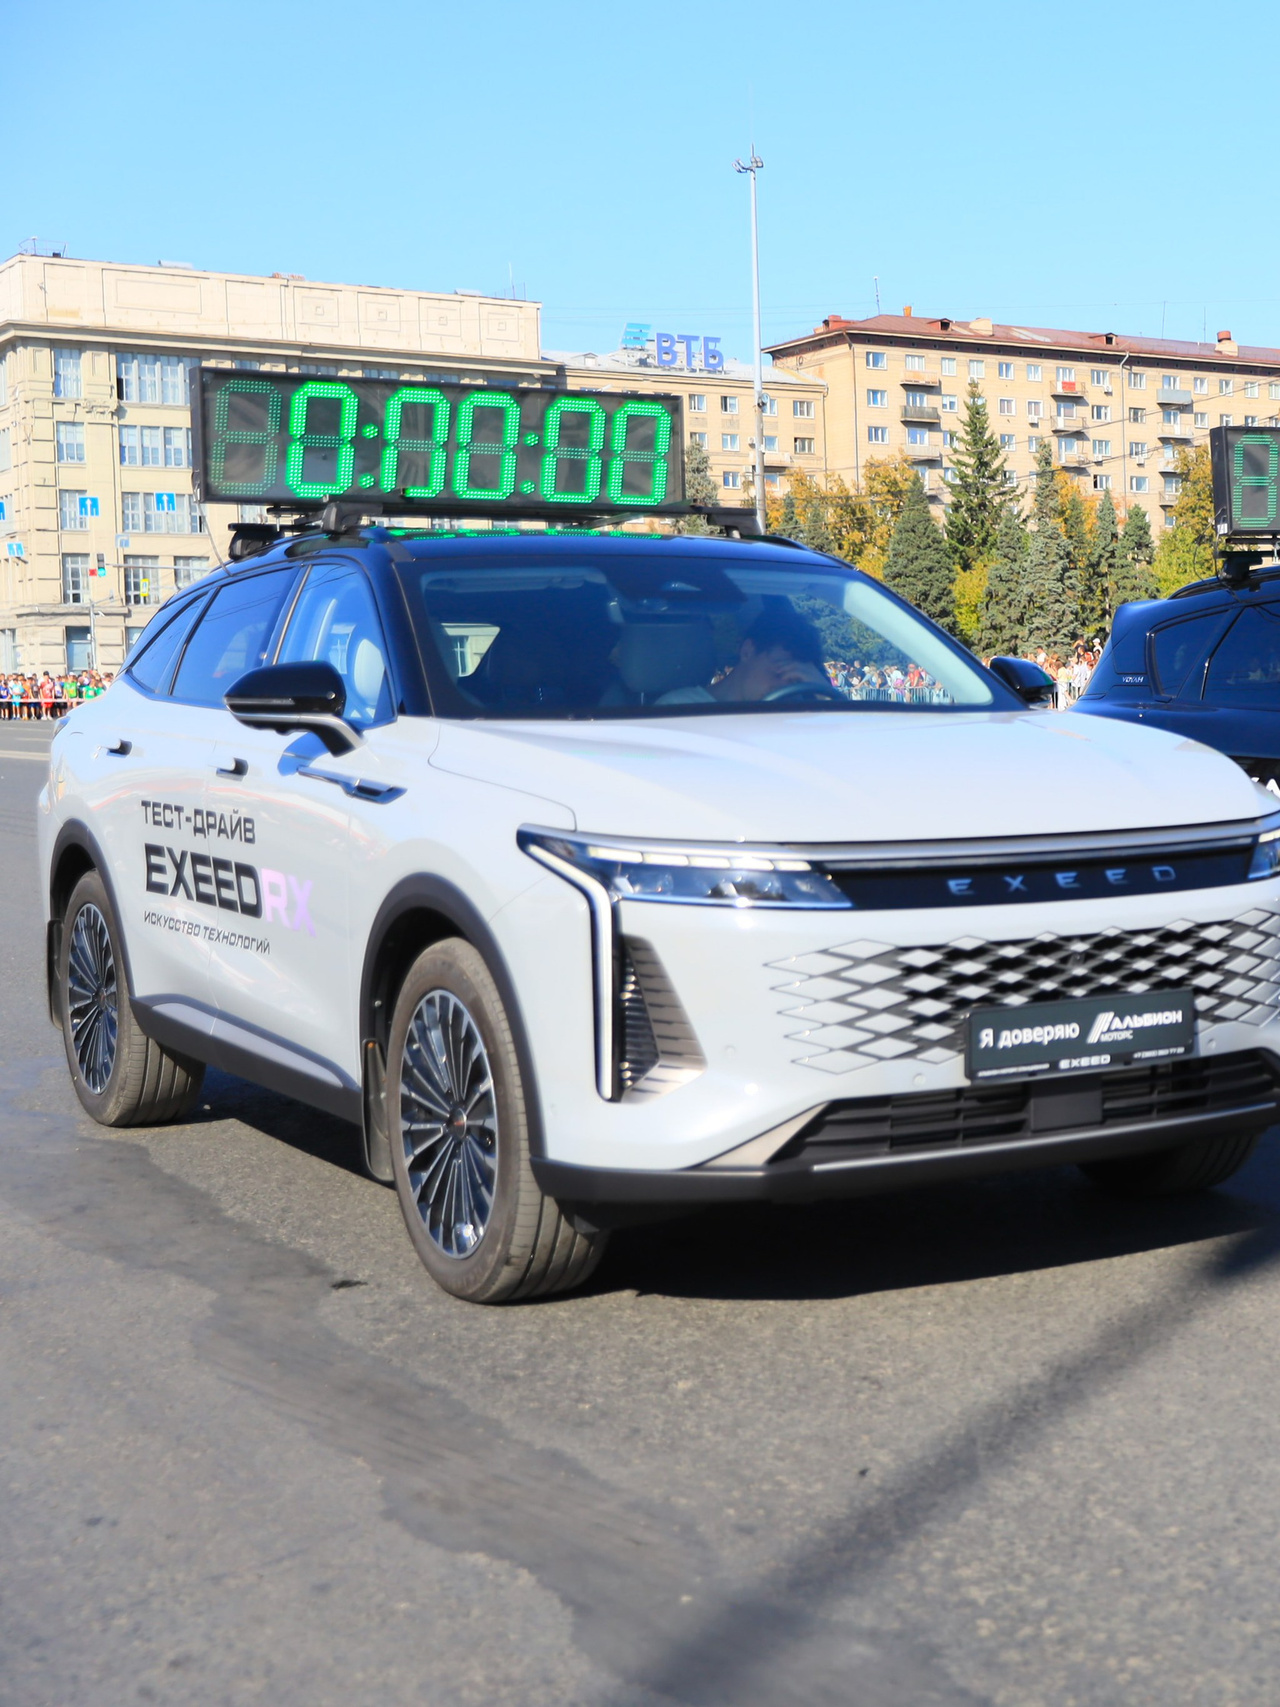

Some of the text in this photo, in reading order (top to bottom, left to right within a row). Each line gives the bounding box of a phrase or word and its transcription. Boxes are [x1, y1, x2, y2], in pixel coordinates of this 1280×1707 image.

[656, 332, 724, 369] ВТБ
[141, 800, 256, 844] ТЕСТ-ДРАЙВ
[947, 866, 1176, 895] EXEED
[144, 910, 270, 955] ИСКУССТВО ТЕХНОЛОГИЙ
[1110, 1010, 1183, 1030] АЛЬБИОН
[979, 1022, 1080, 1049] Я доверяю
[1058, 1054, 1111, 1070] EXEED
